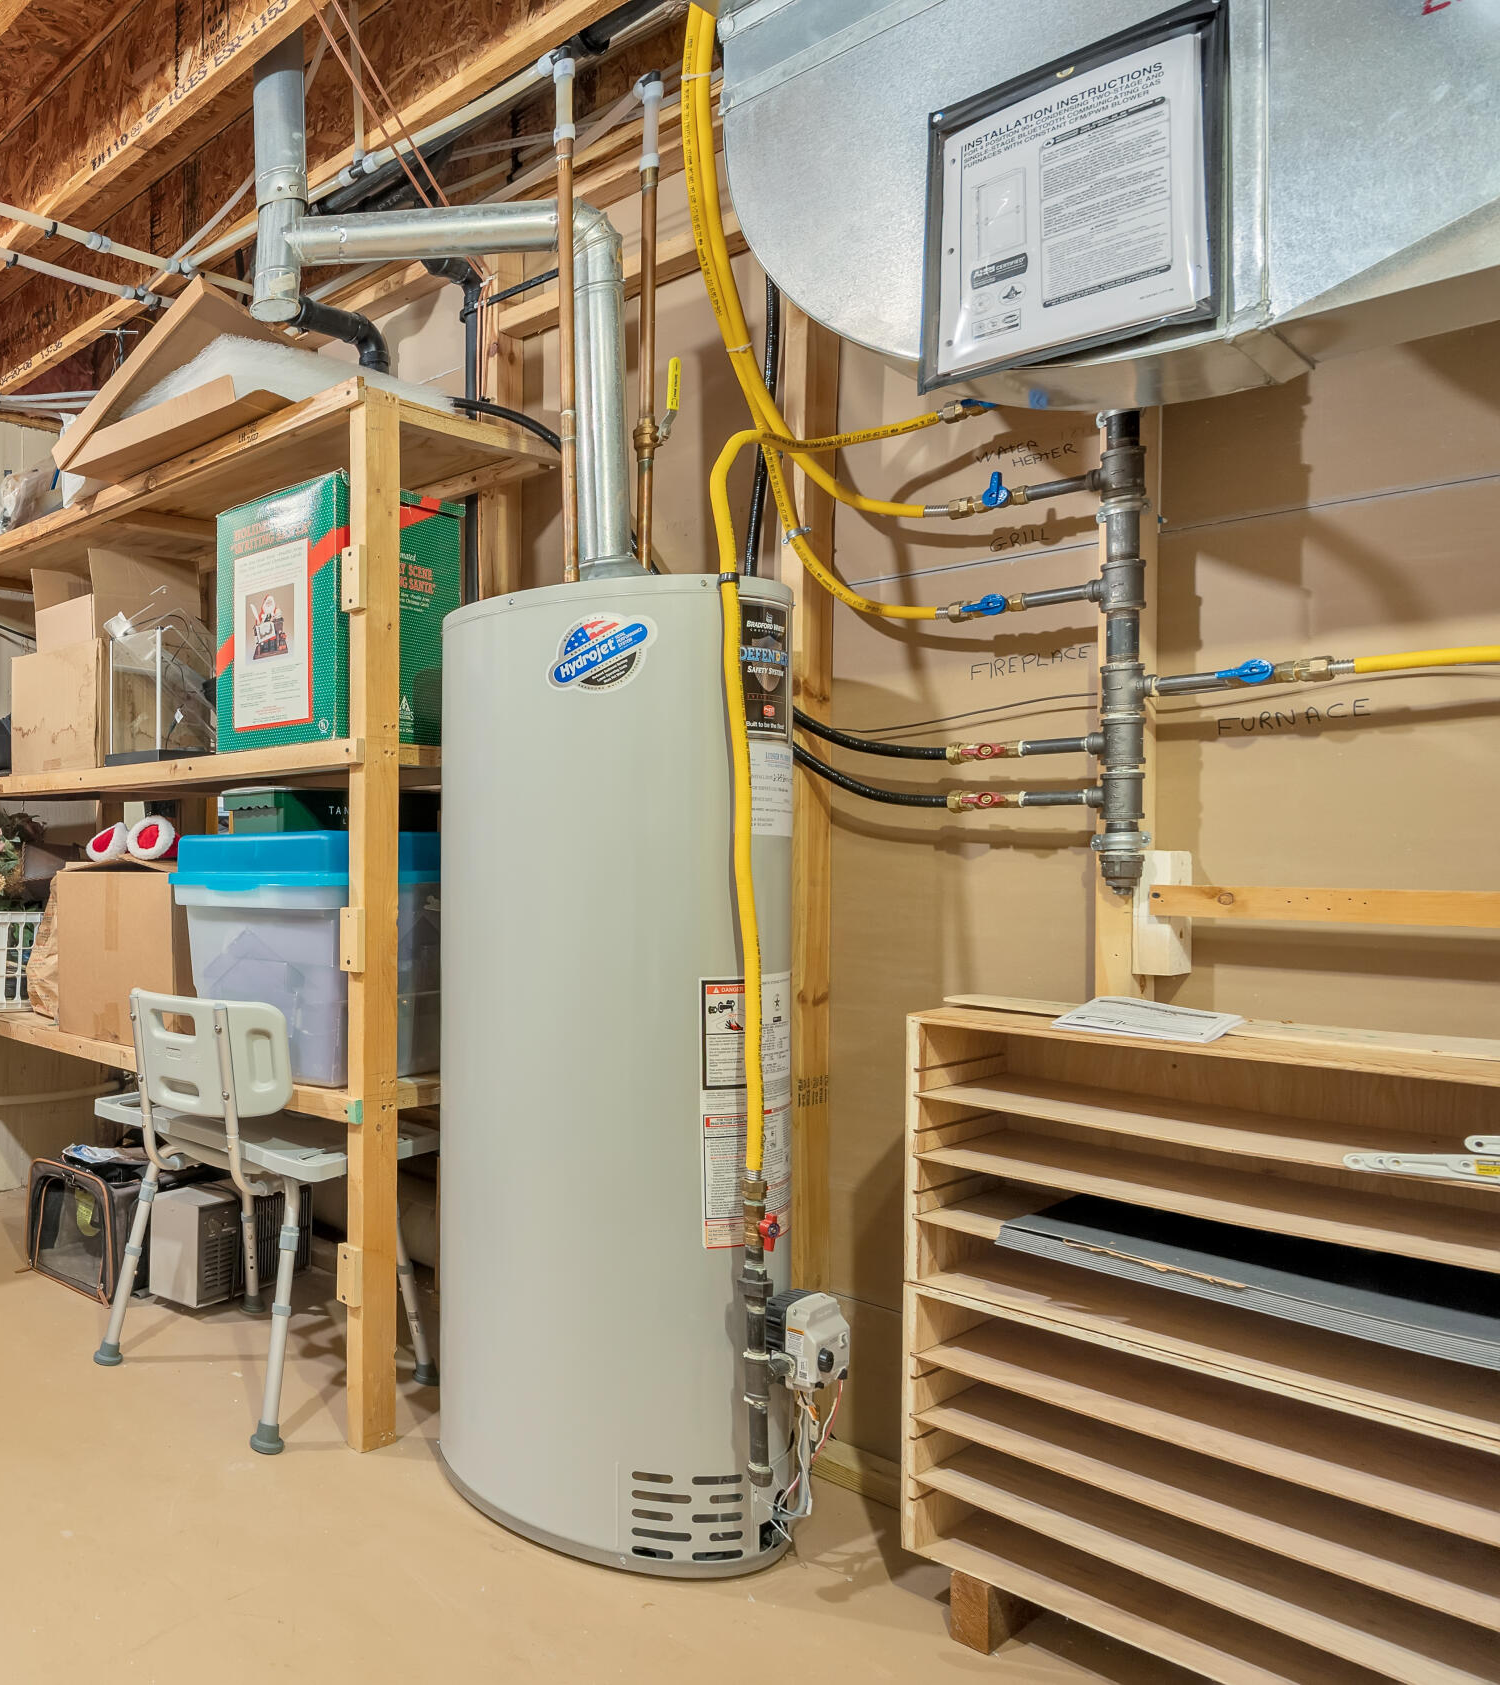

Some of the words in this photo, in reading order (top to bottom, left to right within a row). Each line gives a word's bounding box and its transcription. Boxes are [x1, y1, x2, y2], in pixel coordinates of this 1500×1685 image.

[964, 104, 1053, 151] INSTALLATION
[1057, 62, 1162, 110] INSTRUCTIONS
[964, 148, 979, 158] FOR
[985, 128, 1019, 148] POSITION
[1036, 101, 1088, 126] CONDENSING
[1089, 79, 1143, 105] TWO-STAGE
[1146, 71, 1164, 83] AND
[964, 138, 1016, 163] SINGLE-STAGE
[1018, 115, 1065, 141] BLUETOOTH
[1067, 87, 1141, 122] COMMUNICATING
[1142, 79, 1161, 91] GAS
[964, 150, 1003, 170] FURNACES
[1004, 140, 1023, 152] WITH
[1024, 121, 1067, 143] CONSTANT
[1069, 105, 1109, 125] CFM/PWM
[1111, 89, 1150, 108] BLOWER
[976, 440, 1038, 463] WATER
[1012, 443, 1076, 467] HEATER
[990, 528, 1050, 552] GRILL
[408, 564, 432, 580] SCENE
[746, 620, 773, 630] BRADFORD
[560, 637, 615, 678] Hydrojet
[740, 646, 788, 667] DEFENDER
[747, 665, 768, 674] SAFETY
[970, 644, 1091, 680] FIREPLACE
[1217, 698, 1371, 736] FURNACE
